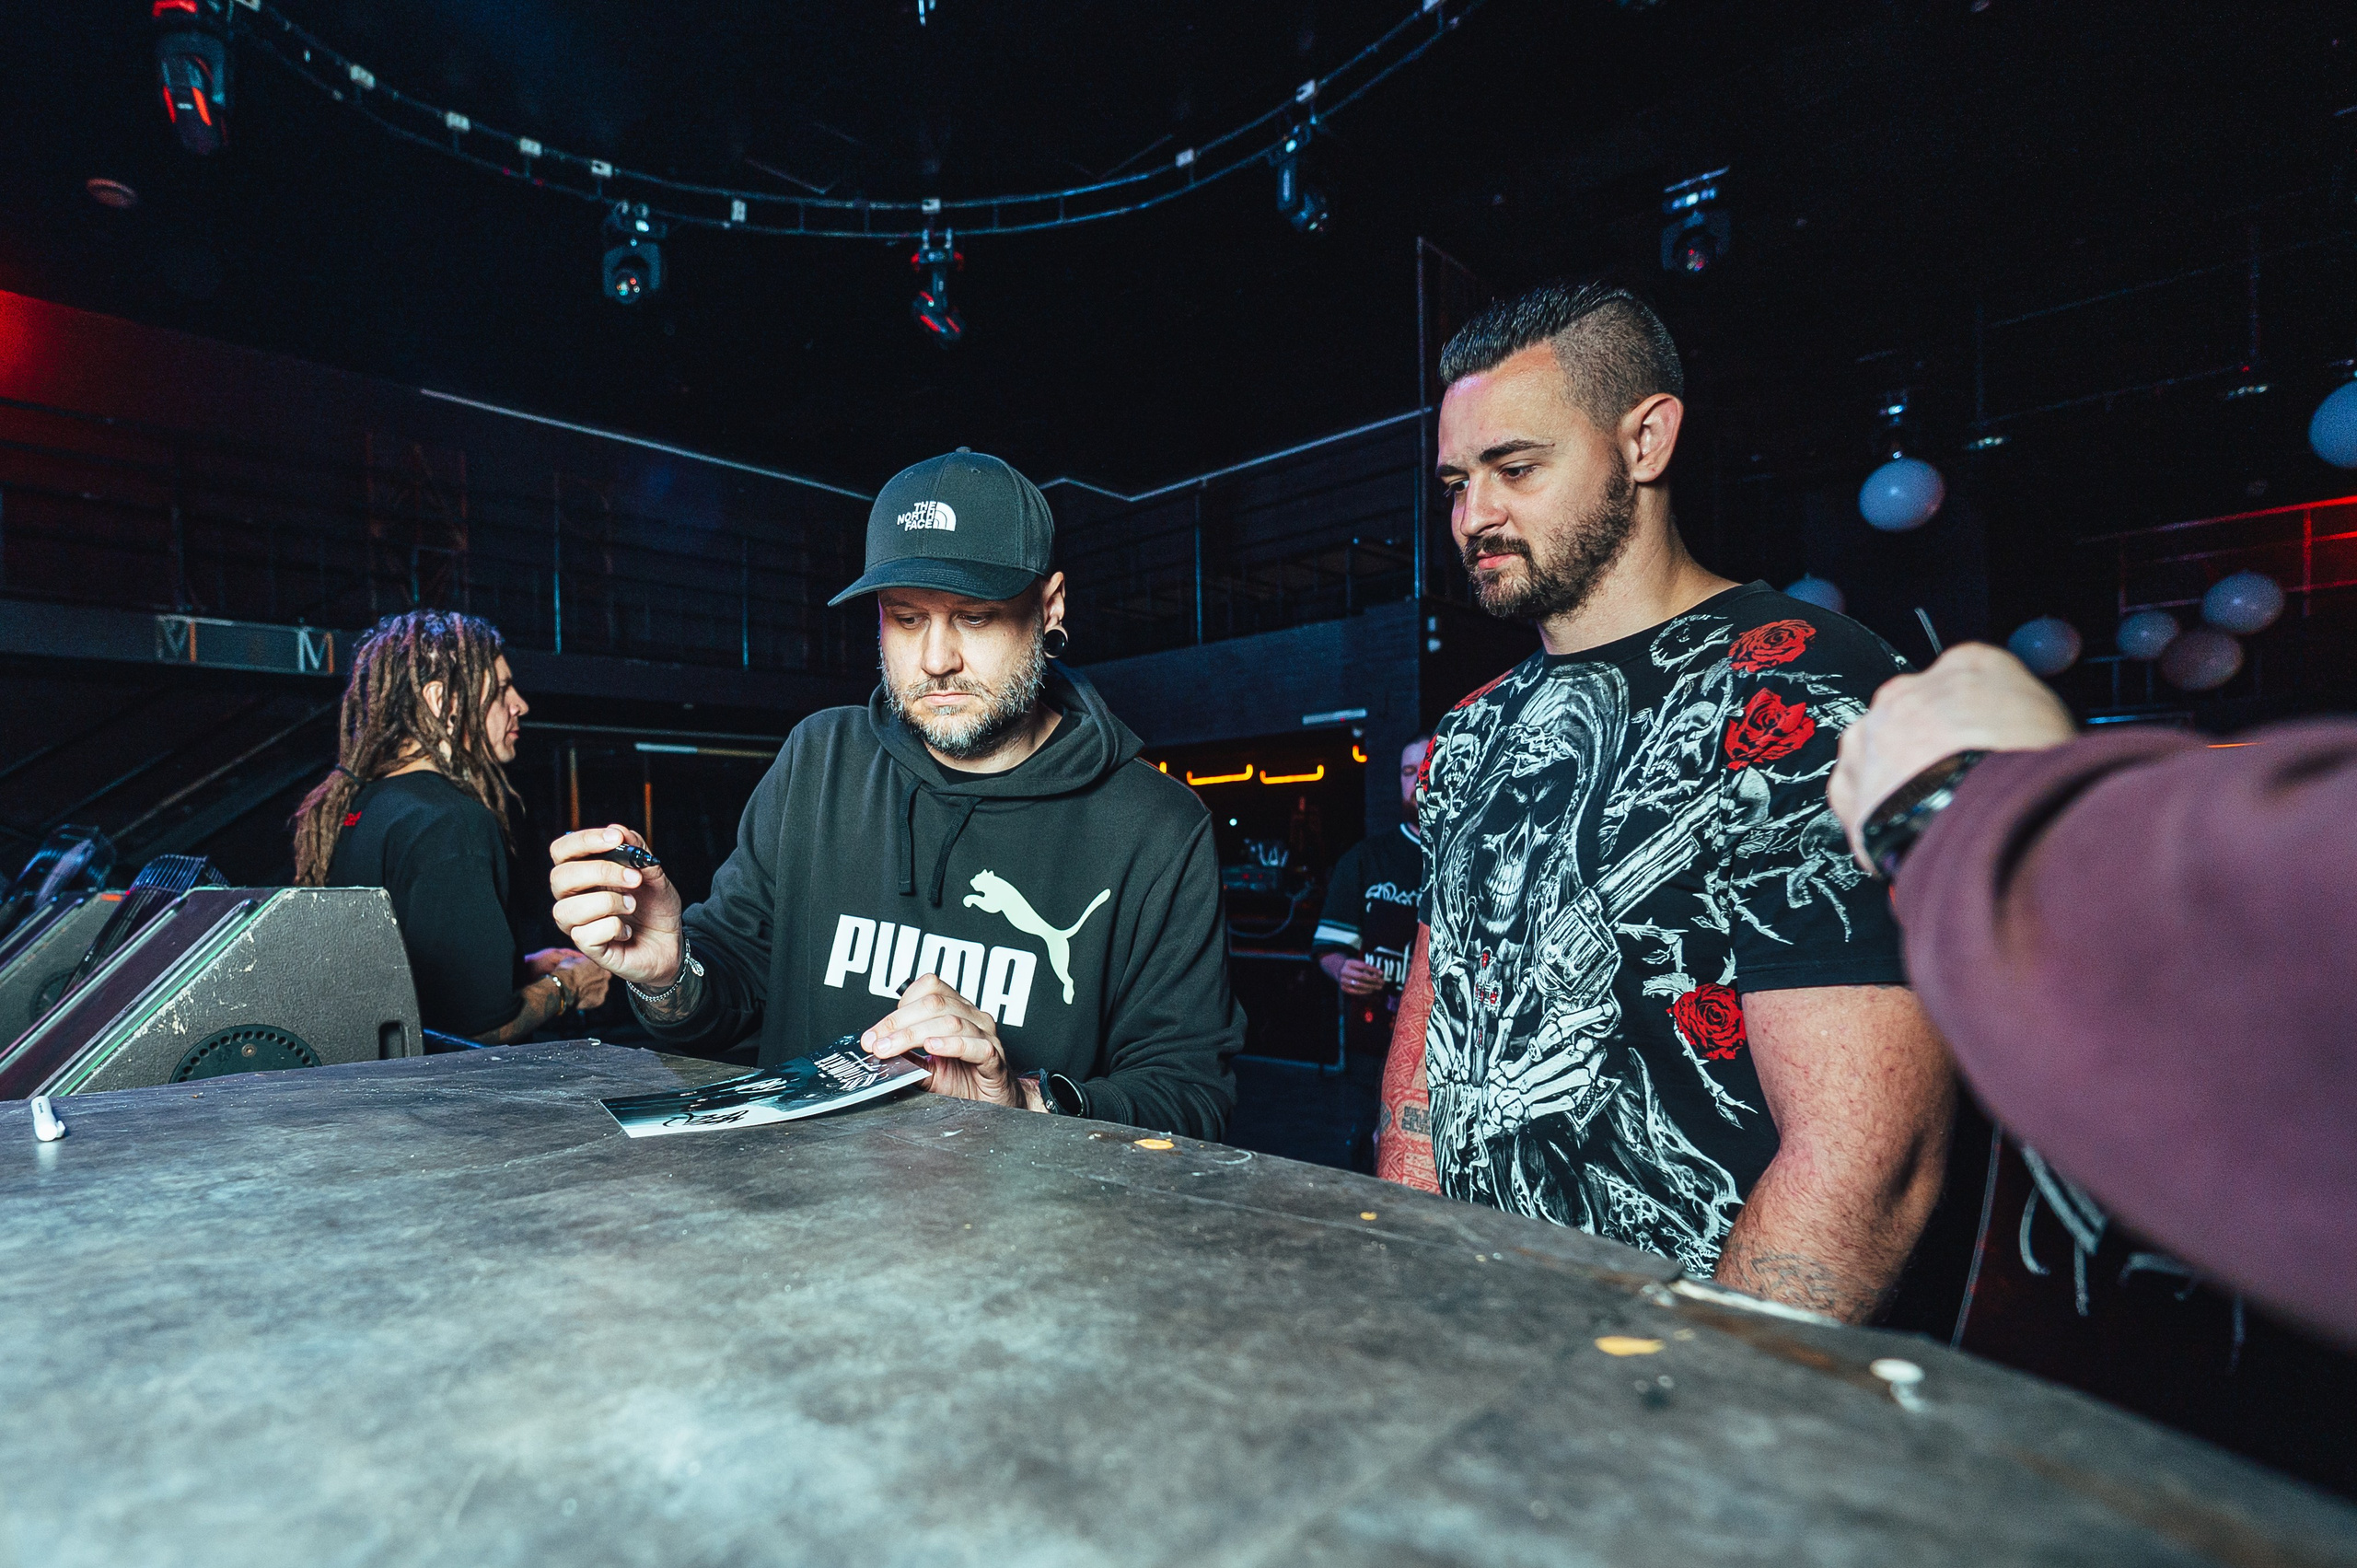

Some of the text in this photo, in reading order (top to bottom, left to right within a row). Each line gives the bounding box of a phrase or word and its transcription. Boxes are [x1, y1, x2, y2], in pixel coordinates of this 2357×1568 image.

[913, 500, 936, 512] THE
[897, 507, 935, 526] NORTH
[904, 519, 933, 531] FACE
[823, 913, 1038, 1028] PUMA
